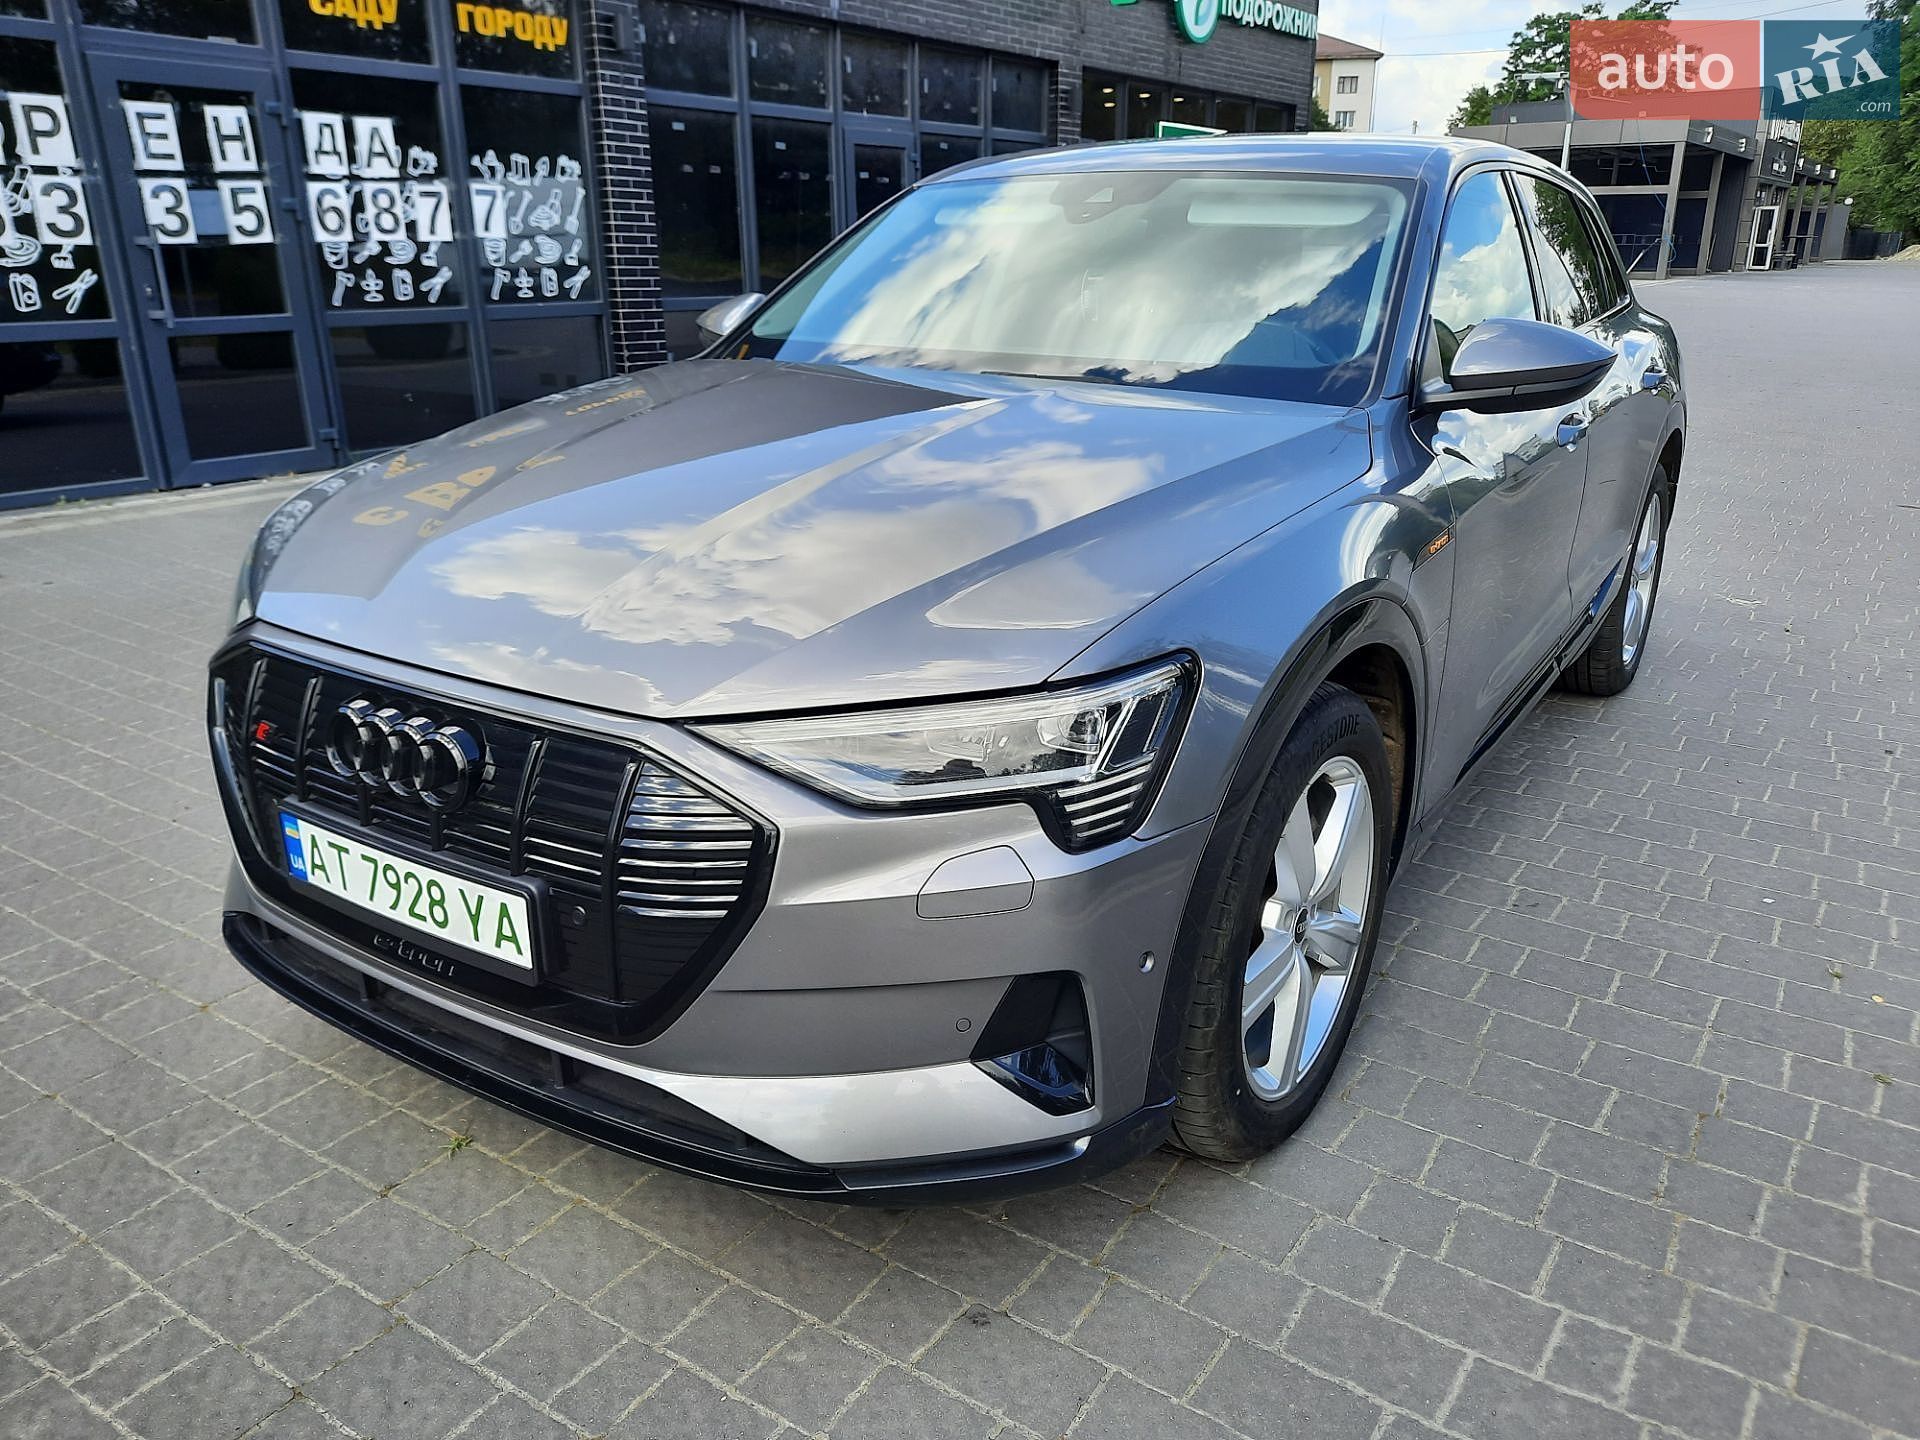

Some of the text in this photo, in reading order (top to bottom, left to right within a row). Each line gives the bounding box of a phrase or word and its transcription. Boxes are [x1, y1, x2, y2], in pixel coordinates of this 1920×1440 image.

[456, 3, 569, 51] ГОРОДУ
[289, 853, 306, 873] UA
[360, 853, 449, 930] 7928
[457, 887, 524, 956] YA
